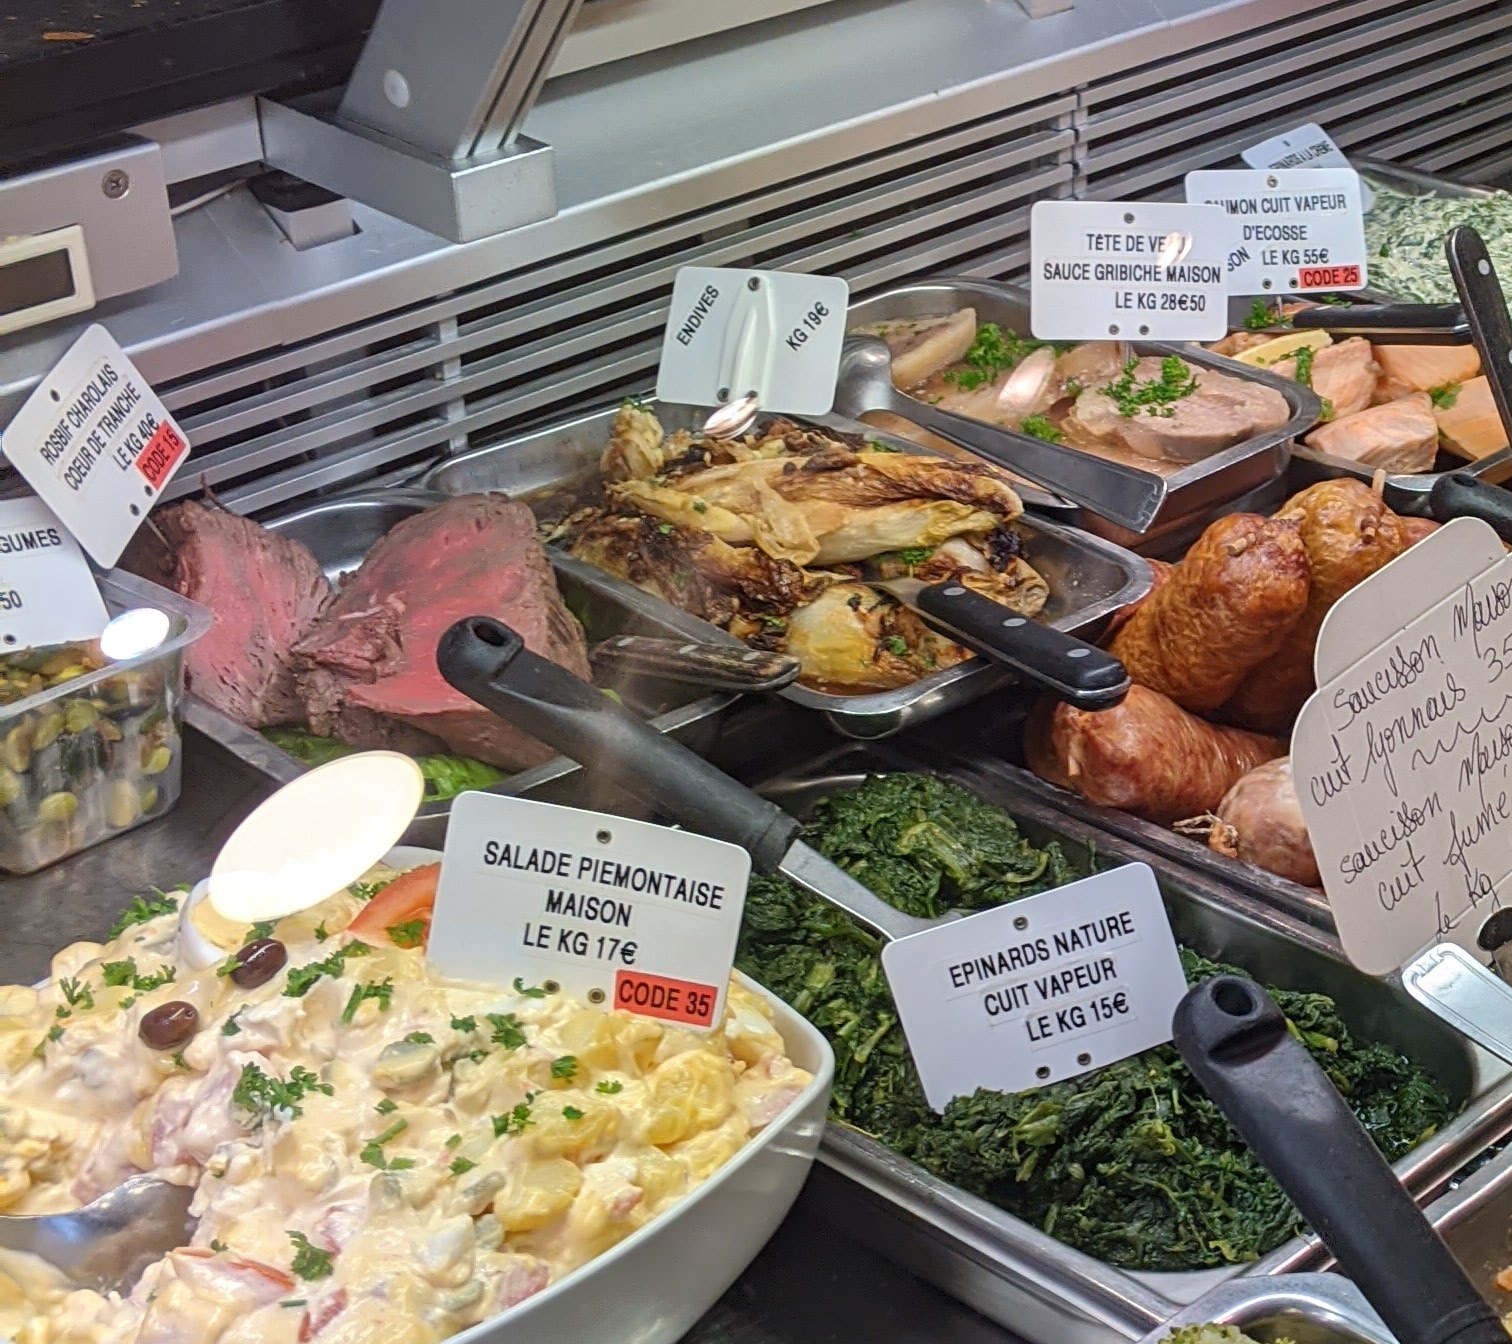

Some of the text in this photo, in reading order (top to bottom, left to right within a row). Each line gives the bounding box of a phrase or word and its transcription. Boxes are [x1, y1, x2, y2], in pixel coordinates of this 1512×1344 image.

[1204, 194, 1347, 215] UMON CUIT VAPEUR
[1086, 233, 1185, 254] TÊTE DE VEU
[1243, 225, 1308, 241] D'ECOSSE
[1262, 248, 1329, 265] LE KG 55€
[1044, 263, 1221, 284] SAUCE GRIBICHE MAISON
[1303, 268, 1359, 287] CODE 25
[676, 284, 720, 346] ENDIVES
[785, 300, 830, 352] KG 19€
[1115, 291, 1206, 312] LE KG 28€50
[39, 363, 119, 466] ROSBIF CHAROLAIS
[63, 381, 142, 491] COEUR DE TRANCHE
[112, 412, 161, 472] LE KG 40€
[142, 427, 180, 481] CODE 15
[1310, 736, 1352, 807] cuit
[1362, 674, 1467, 795] lyonnais
[483, 840, 725, 910] SALADE PIEMONTAISE
[1378, 847, 1426, 911] cuit
[545, 889, 632, 928] MAISON
[522, 922, 639, 965] LE KG 17€
[949, 911, 1135, 988] EPINARDS NATURE
[618, 978, 711, 1018] CODE 35
[984, 957, 1118, 1017] CUIT VAPEUR
[1026, 992, 1130, 1042] LE KG 15€
